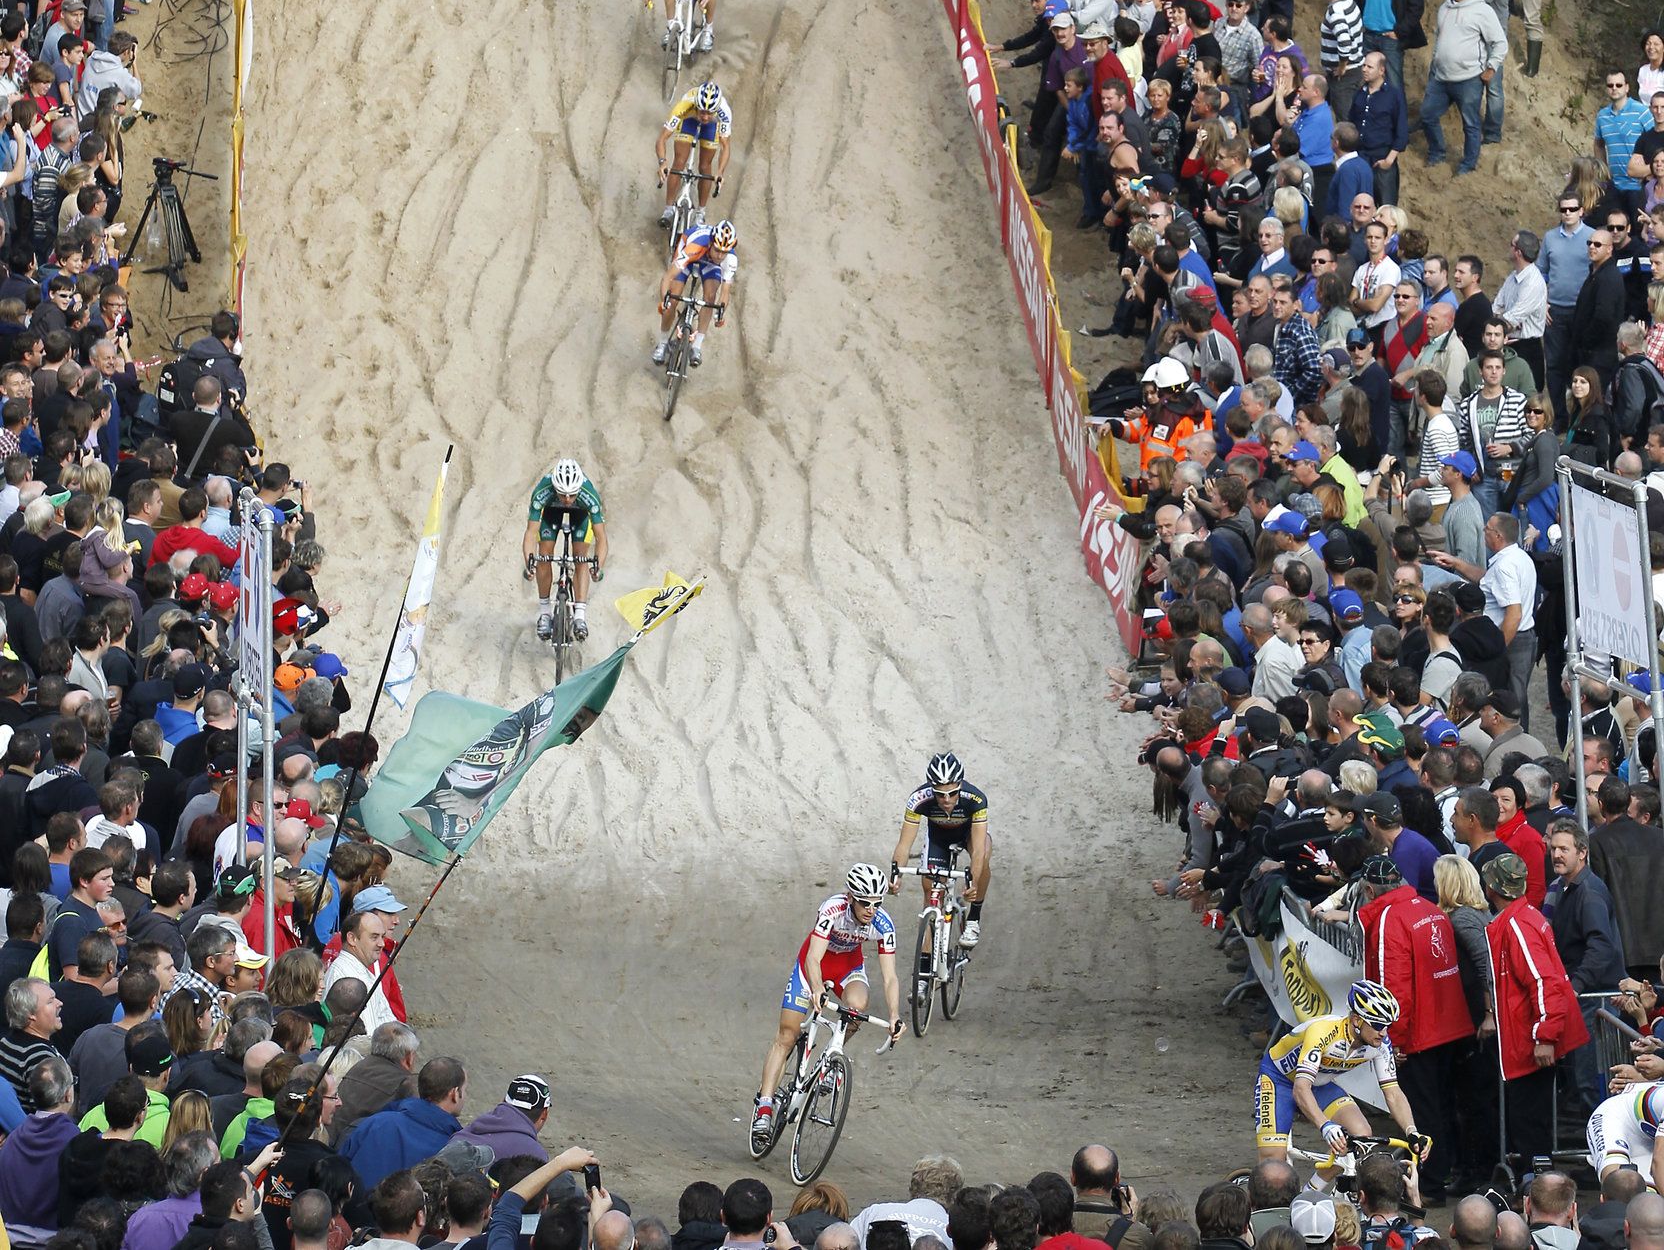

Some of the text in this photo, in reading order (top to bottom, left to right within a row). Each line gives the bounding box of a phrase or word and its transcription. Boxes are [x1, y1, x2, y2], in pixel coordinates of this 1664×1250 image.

[1009, 186, 1047, 361] NISSAN
[818, 918, 831, 932] 4
[885, 933, 895, 948] 4
[1279, 1045, 1303, 1075] FID
[1307, 1048, 1320, 1064] 6
[1261, 1091, 1273, 1129] telenet
